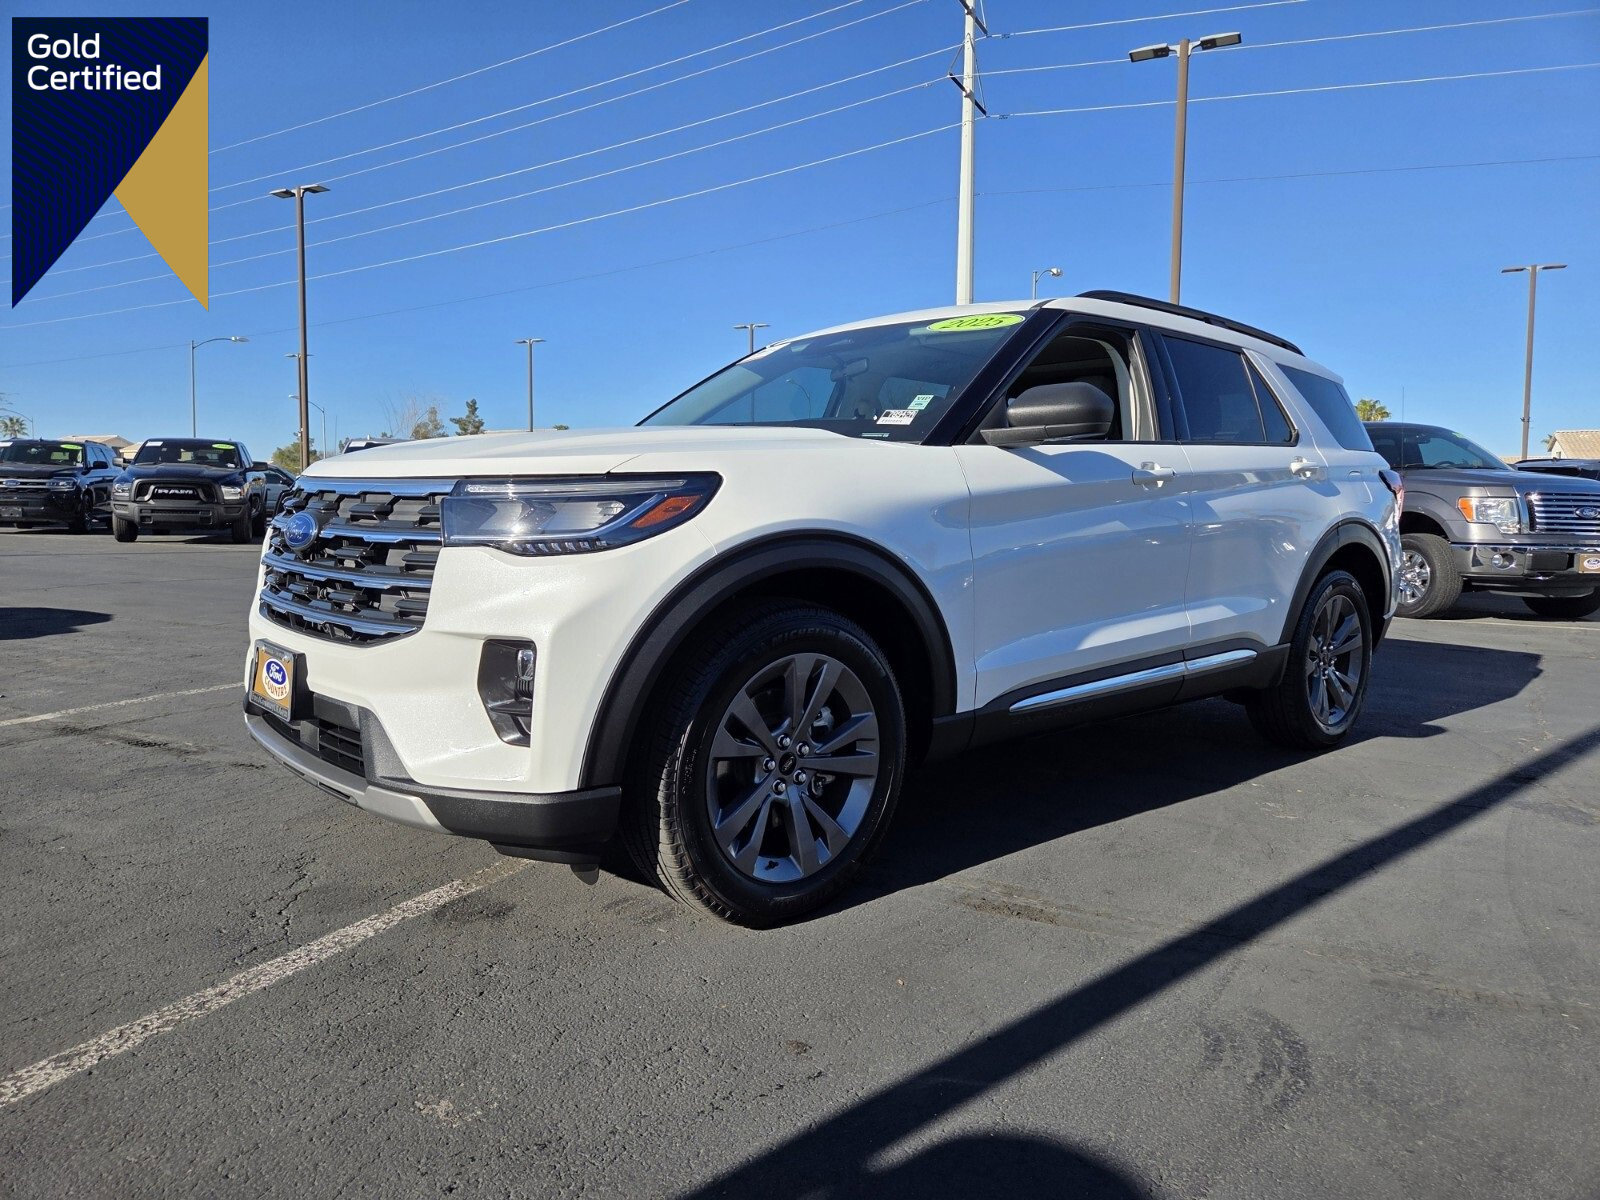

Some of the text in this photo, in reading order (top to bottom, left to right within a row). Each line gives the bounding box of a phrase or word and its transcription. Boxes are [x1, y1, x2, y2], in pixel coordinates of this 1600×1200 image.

[939, 317, 1009, 329] 2025
[286, 519, 307, 539] Ford
[269, 663, 283, 682] Ford
